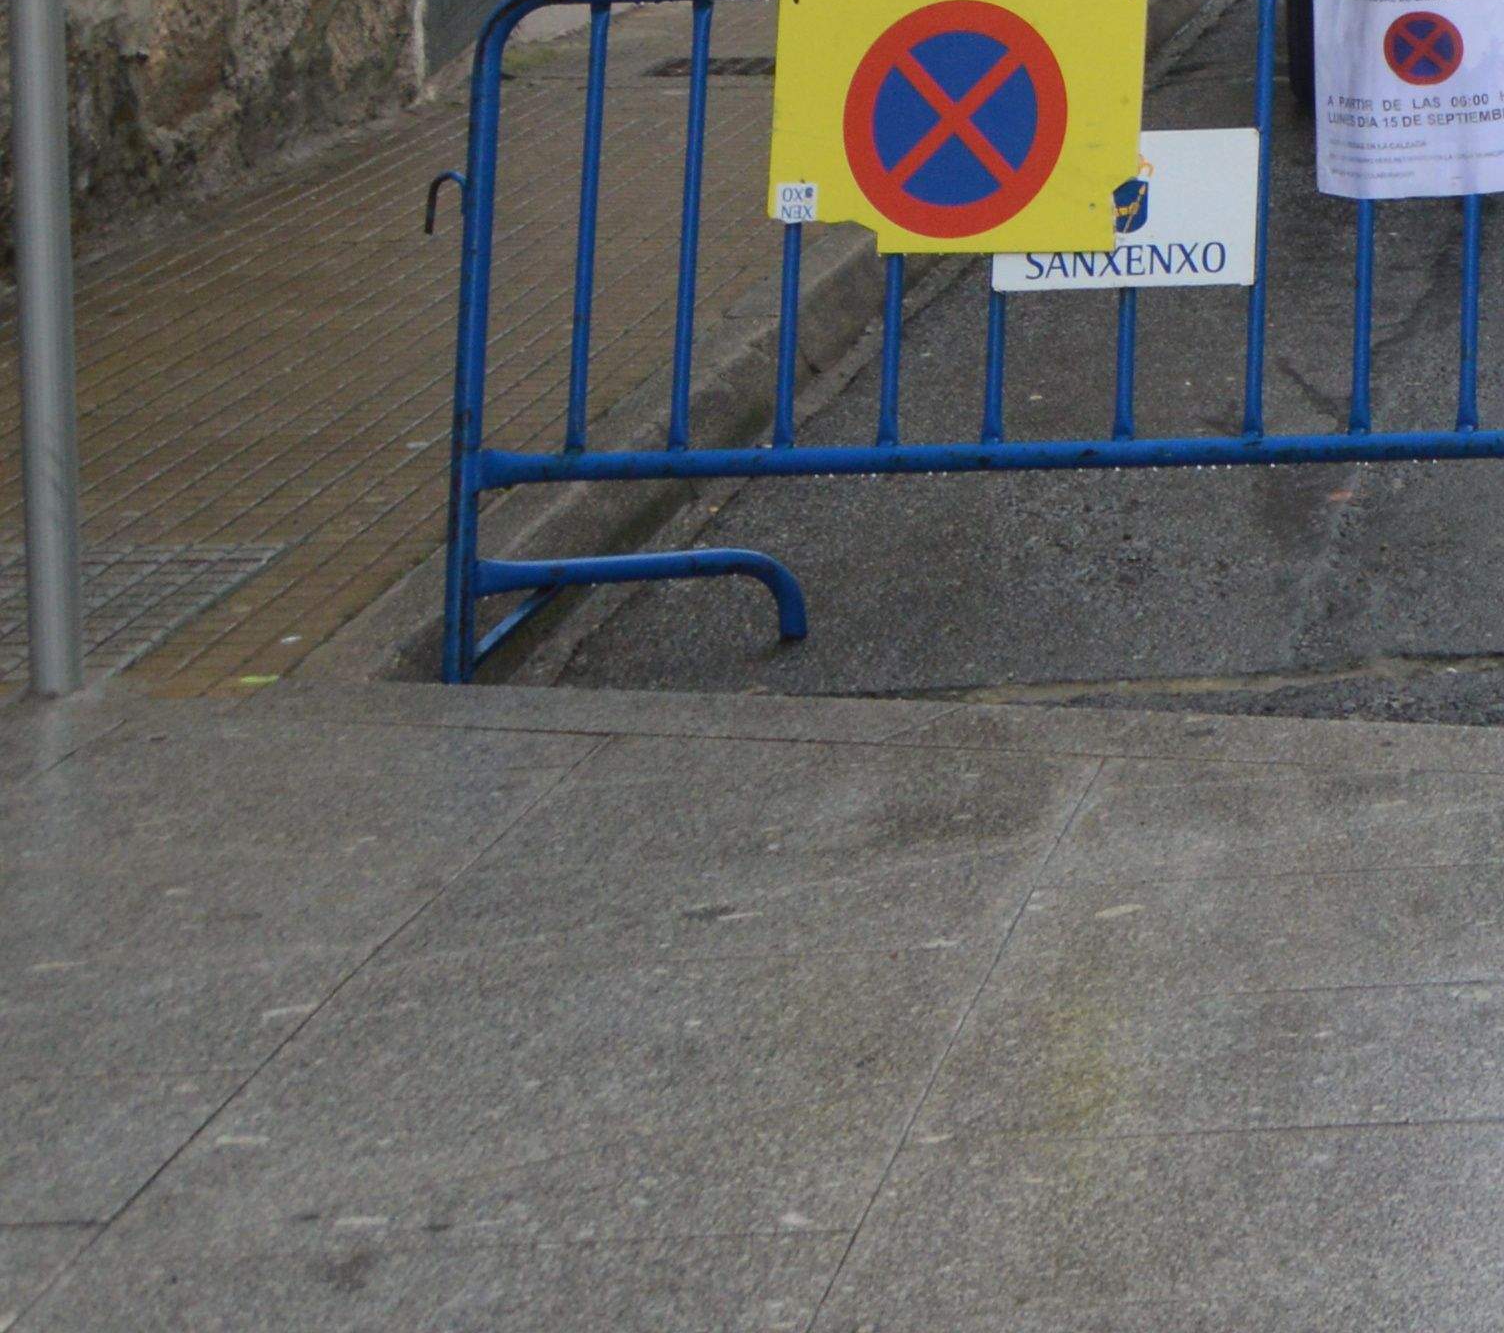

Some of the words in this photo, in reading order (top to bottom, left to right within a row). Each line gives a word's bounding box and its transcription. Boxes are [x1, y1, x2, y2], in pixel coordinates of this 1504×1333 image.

[1382, 99, 1402, 112] DE
[1413, 96, 1441, 110] LAS
[1383, 116, 1398, 128] 15
[1403, 115, 1422, 127] DE
[1025, 241, 1227, 280] SANXENXO
